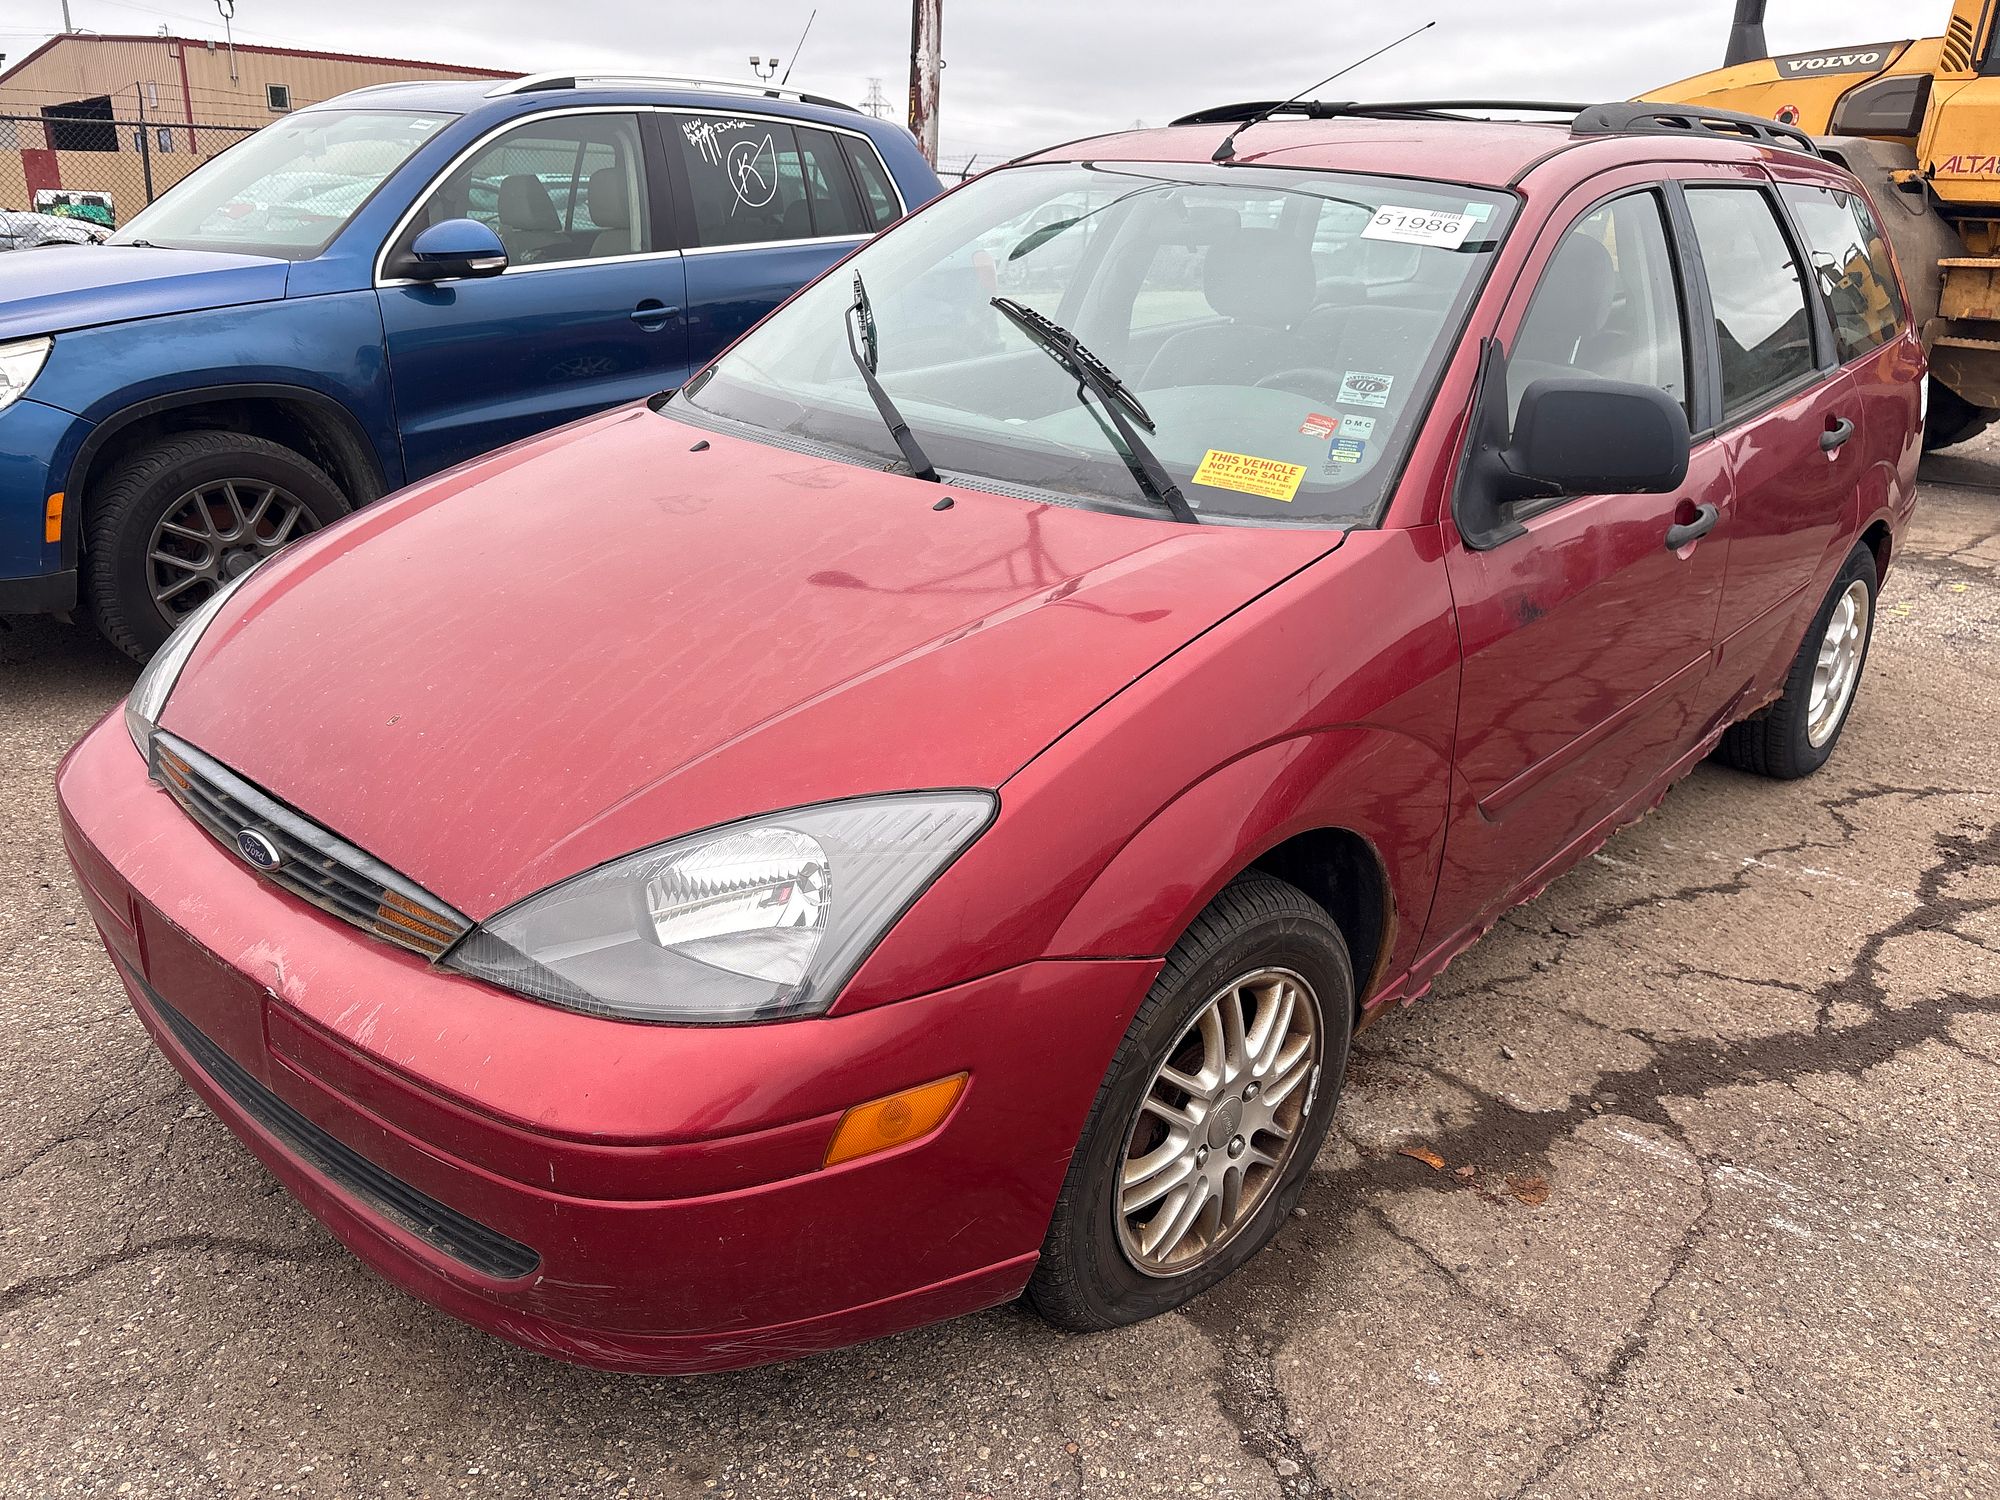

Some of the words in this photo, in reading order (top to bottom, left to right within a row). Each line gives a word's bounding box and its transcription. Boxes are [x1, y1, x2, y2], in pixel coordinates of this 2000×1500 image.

[1787, 52, 1880, 72] VOLVO
[1375, 213, 1460, 234] 51986
[1355, 380, 1375, 391] 06
[1208, 461, 1232, 471] NOT
[1234, 466, 1258, 477] FOR
[1261, 471, 1291, 483] SALE
[1211, 452, 1240, 465] THIS
[1243, 457, 1299, 476] VEHICLE
